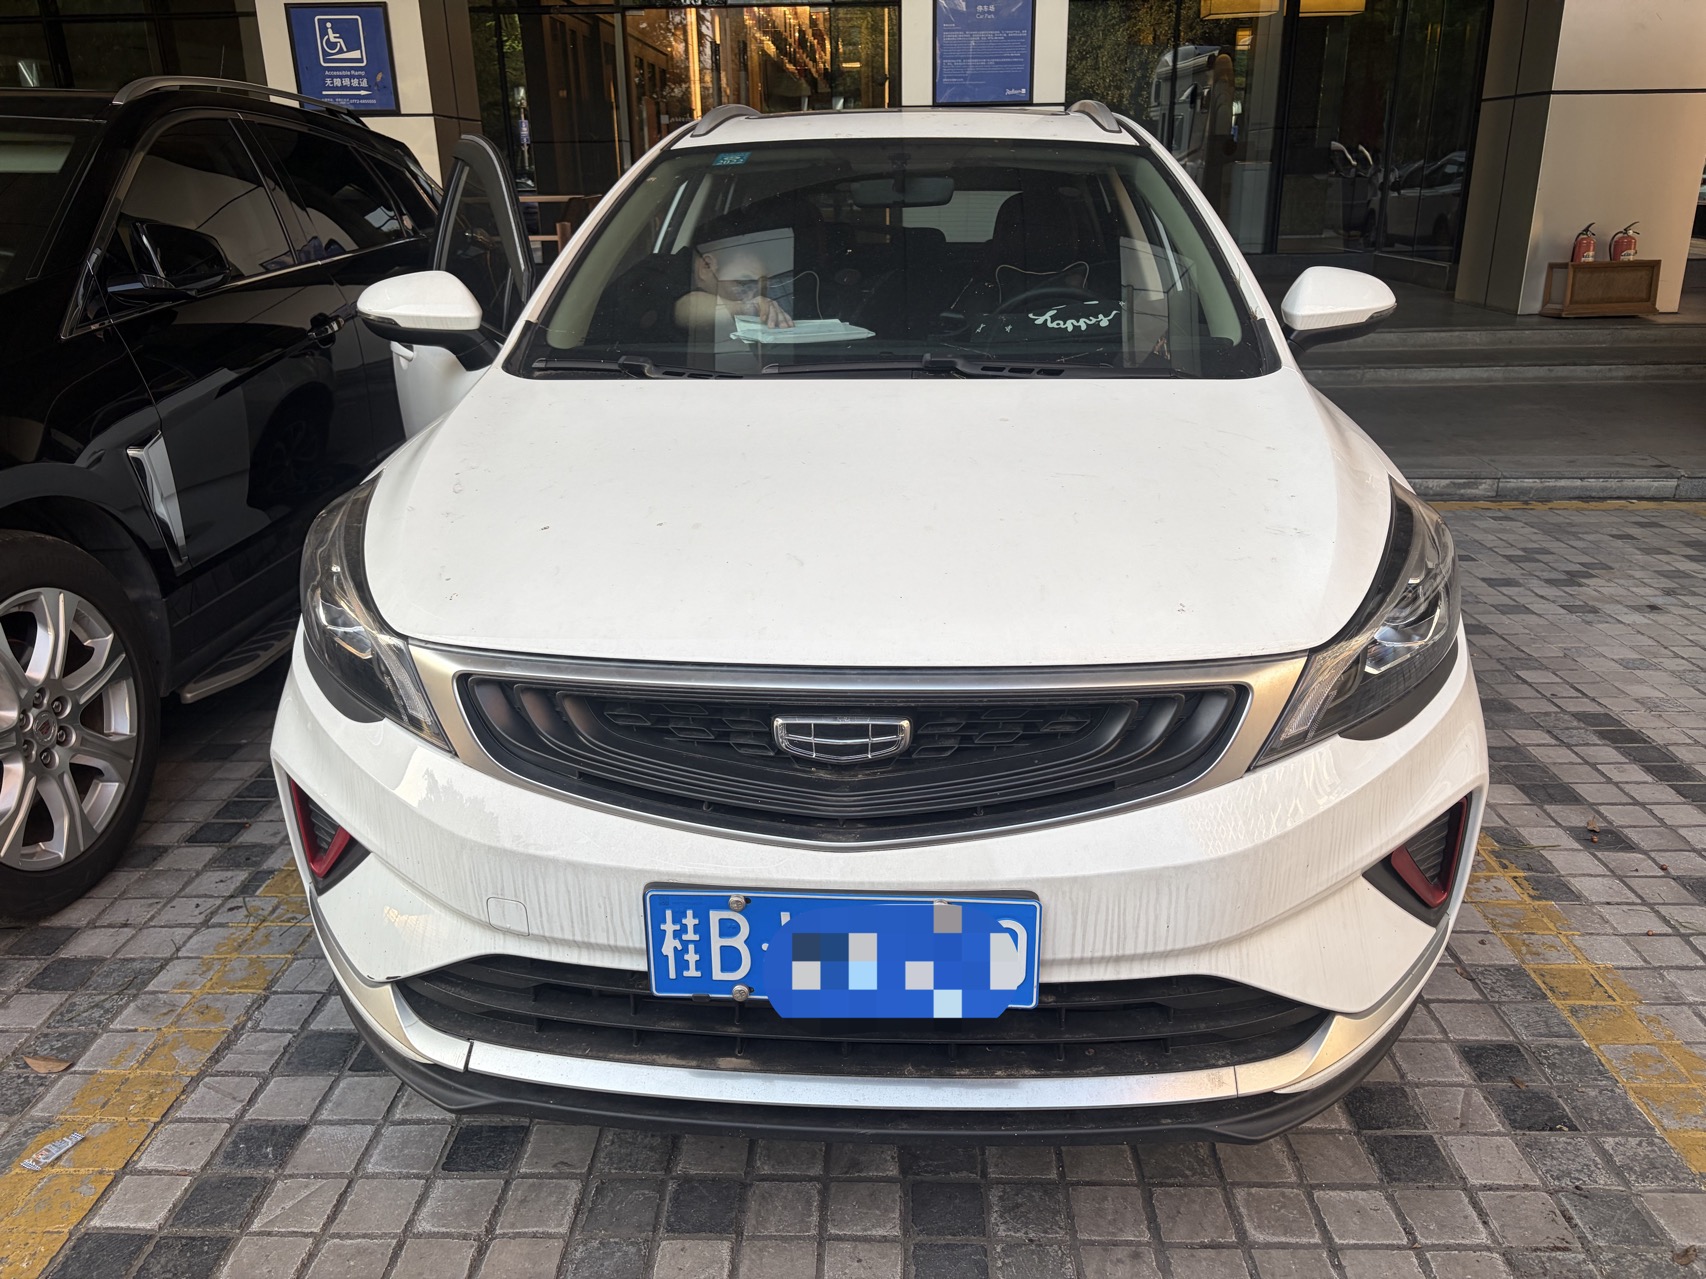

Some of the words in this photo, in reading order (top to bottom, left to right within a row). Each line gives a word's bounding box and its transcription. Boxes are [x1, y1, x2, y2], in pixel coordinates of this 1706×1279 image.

[325, 78, 368, 87] 无障碍坡道
